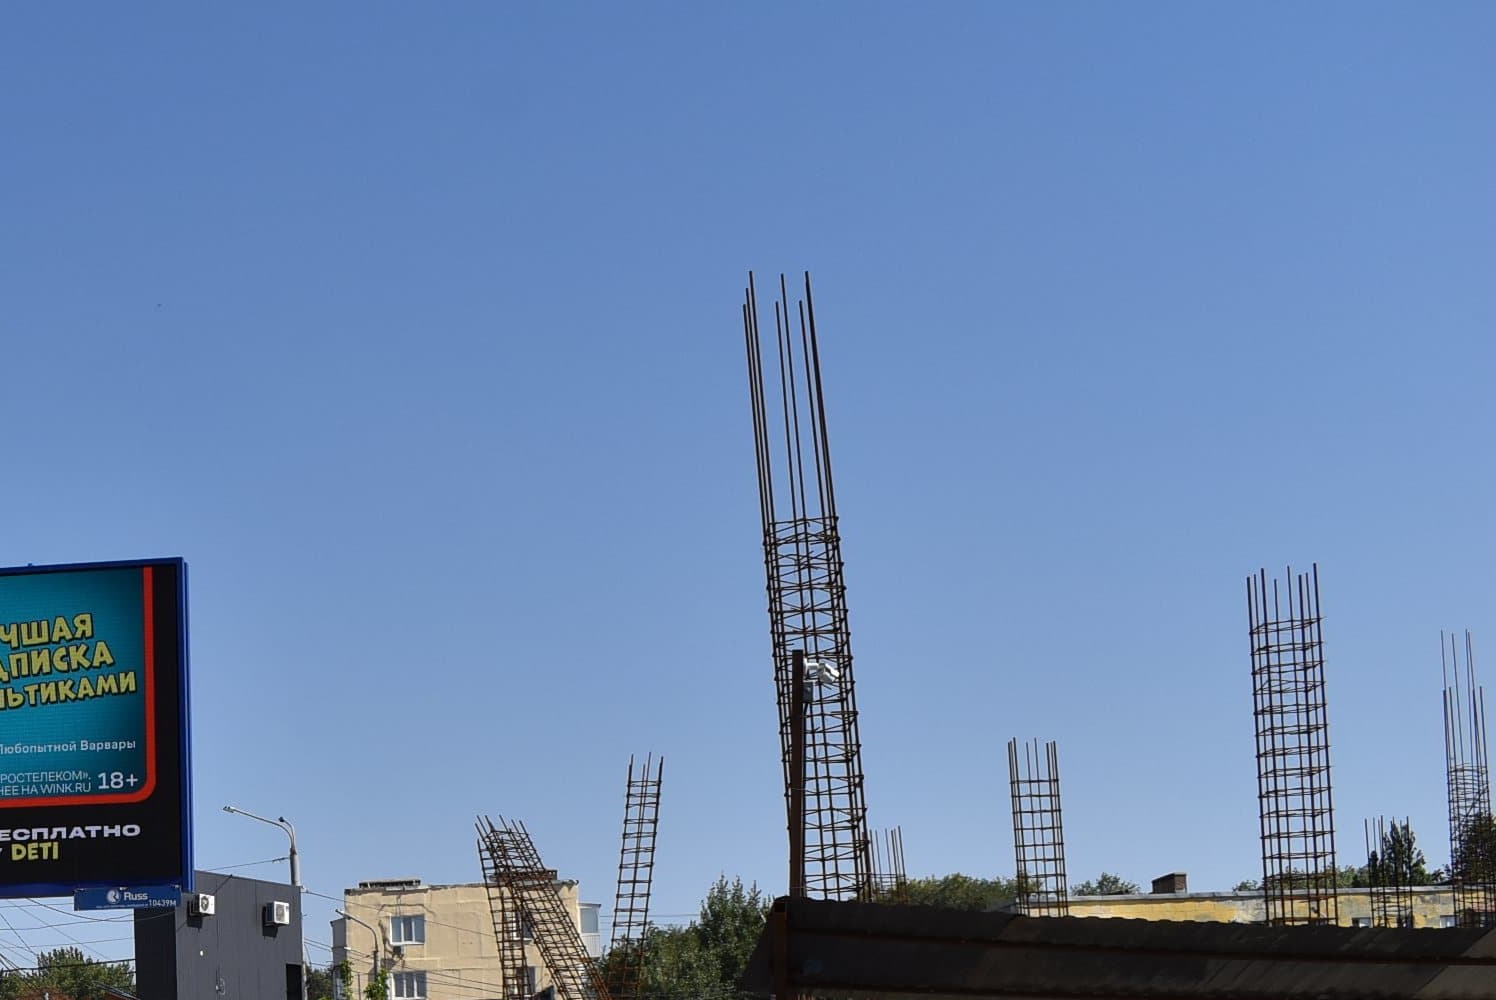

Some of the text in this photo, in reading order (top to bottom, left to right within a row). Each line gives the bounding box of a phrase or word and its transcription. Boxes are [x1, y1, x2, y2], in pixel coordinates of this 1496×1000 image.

[81, 739, 136, 754] Варвары
[21, 783, 38, 795] НА
[40, 781, 92, 794] WINK.RU
[97, 771, 139, 790] 18+
[11, 841, 59, 861] DETI
[124, 891, 149, 901] Russ
